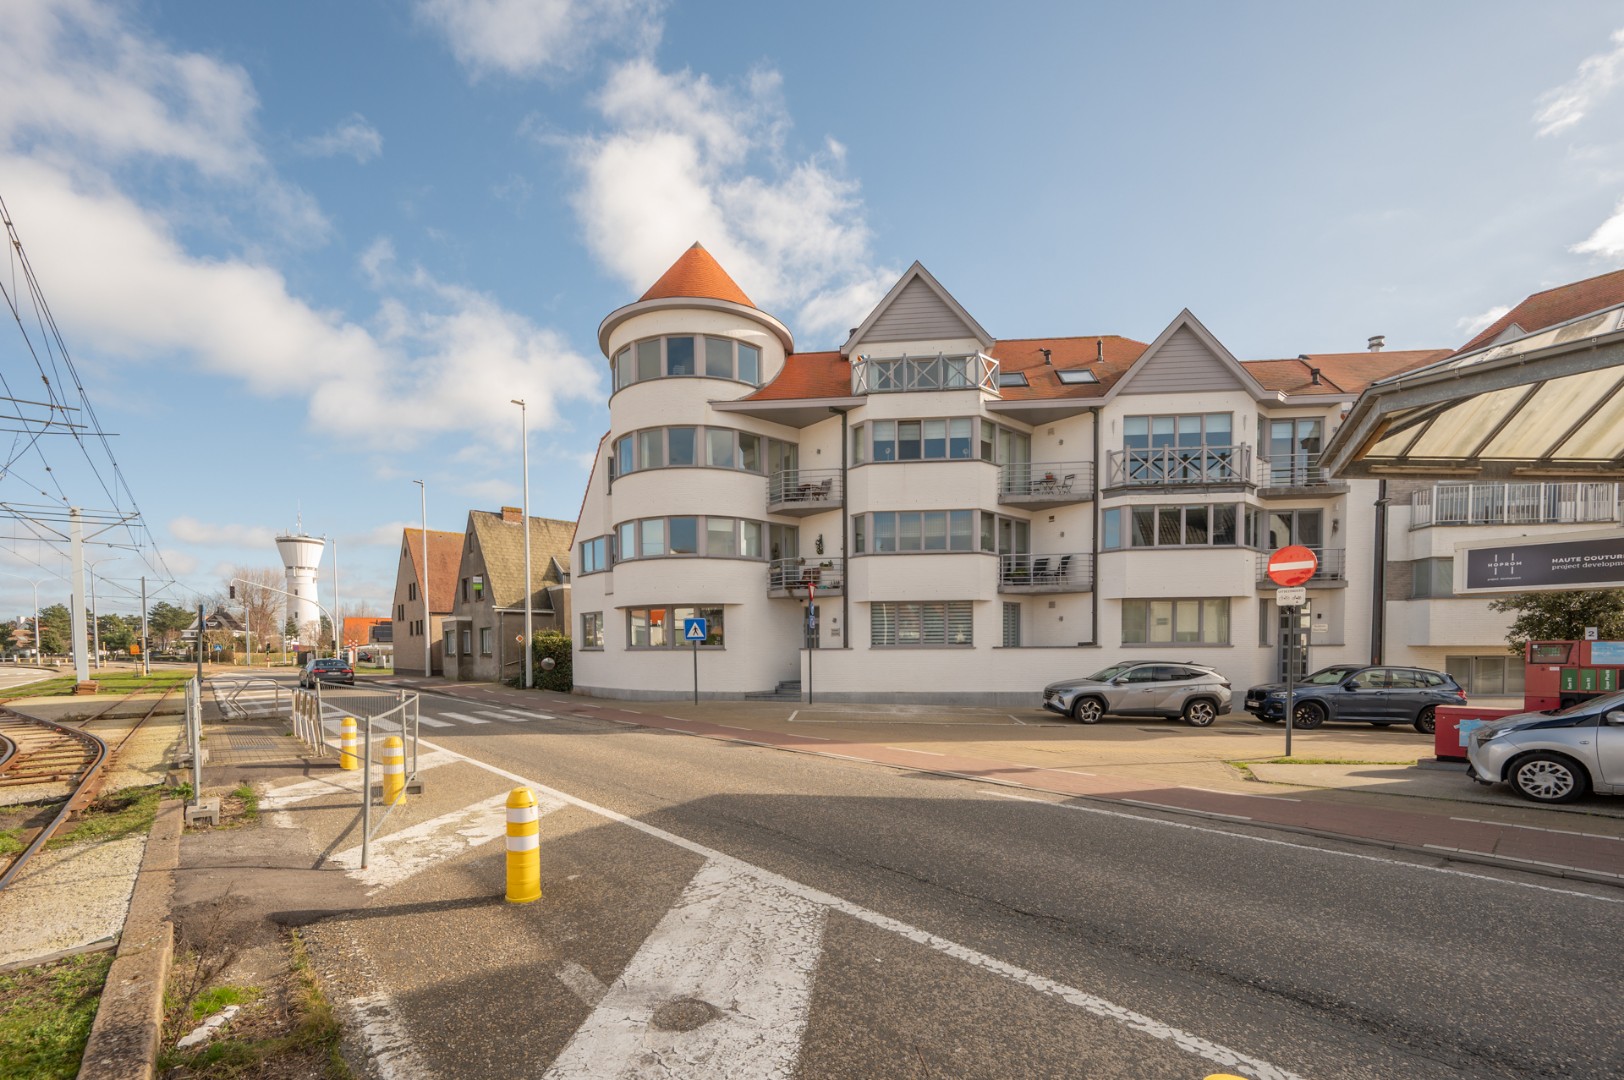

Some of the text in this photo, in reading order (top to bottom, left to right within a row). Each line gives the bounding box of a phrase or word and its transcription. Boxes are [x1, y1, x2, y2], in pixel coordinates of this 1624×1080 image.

[1552, 554, 1624, 564] HAUTE COUTUR
[1552, 563, 1580, 571] project
